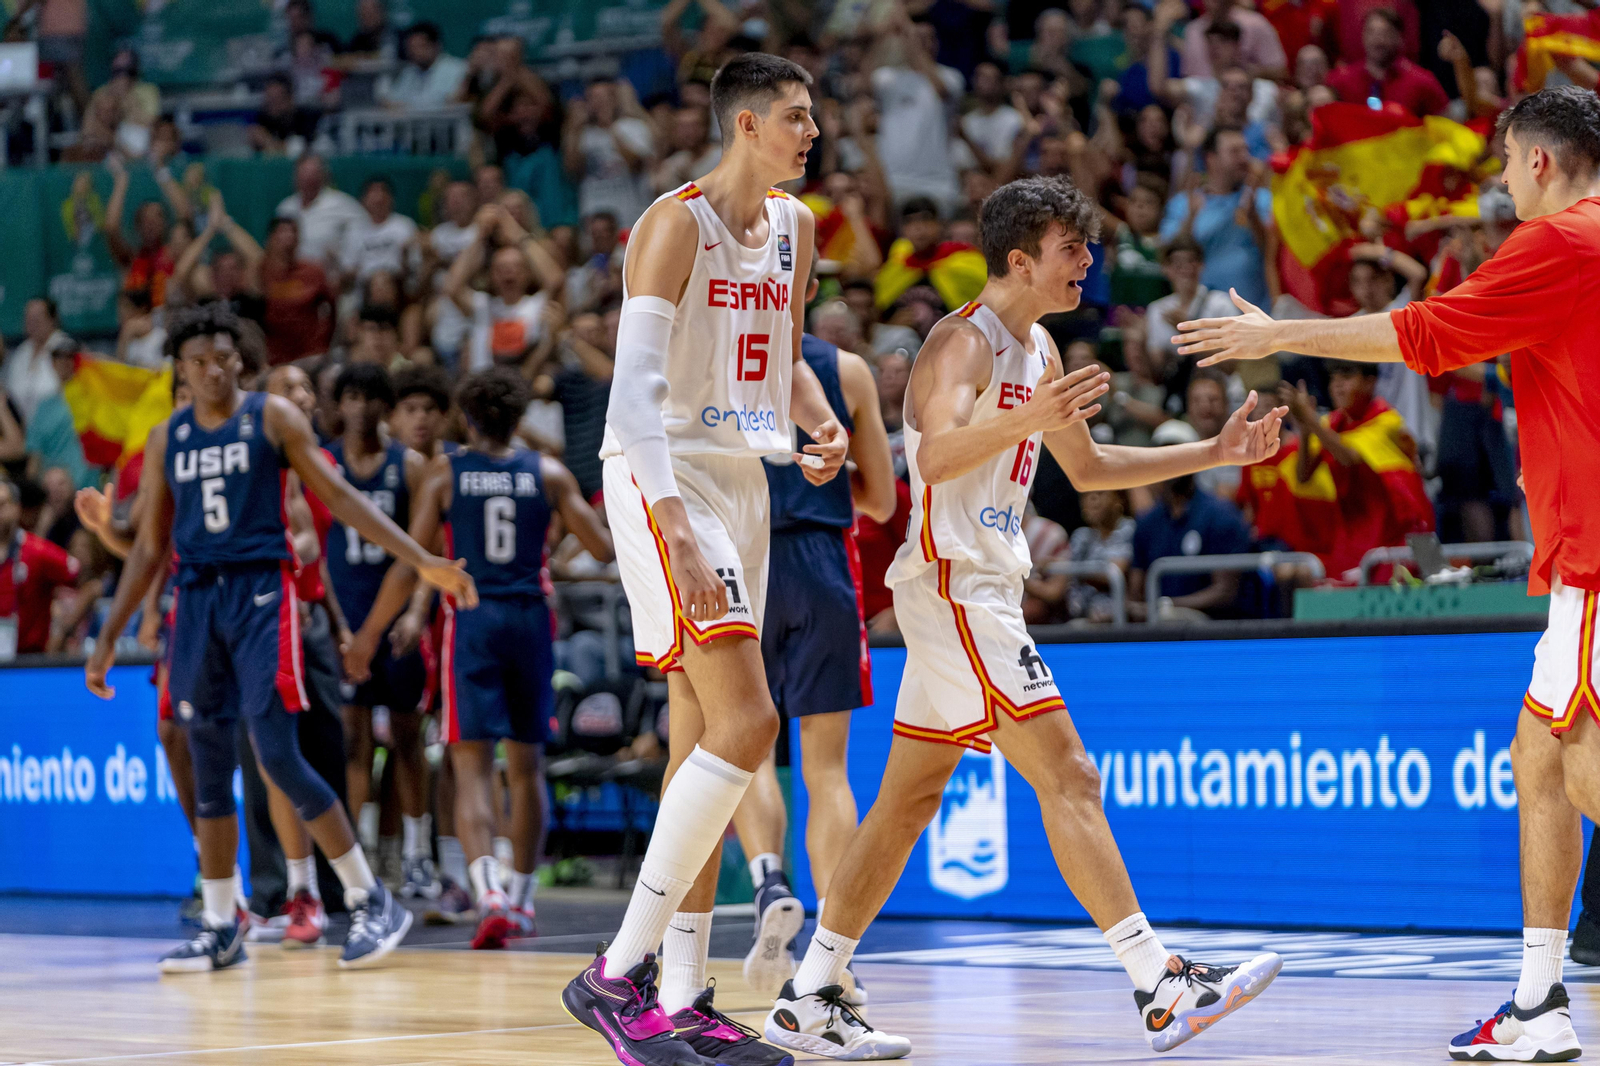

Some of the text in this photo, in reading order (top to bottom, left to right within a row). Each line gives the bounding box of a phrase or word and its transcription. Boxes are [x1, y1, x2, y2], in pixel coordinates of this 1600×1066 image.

[708, 277, 788, 311] ESPAÑA
[737, 333, 770, 381] 15
[701, 404, 776, 431] endesa
[997, 382, 1033, 410] ESP
[174, 441, 250, 483] USA
[1009, 438, 1035, 487] 16
[201, 476, 230, 533] 5
[484, 495, 516, 565] 6
[729, 604, 749, 614] work
[104, 742, 147, 804] de
[1087, 729, 1519, 809] yuntamiento de
